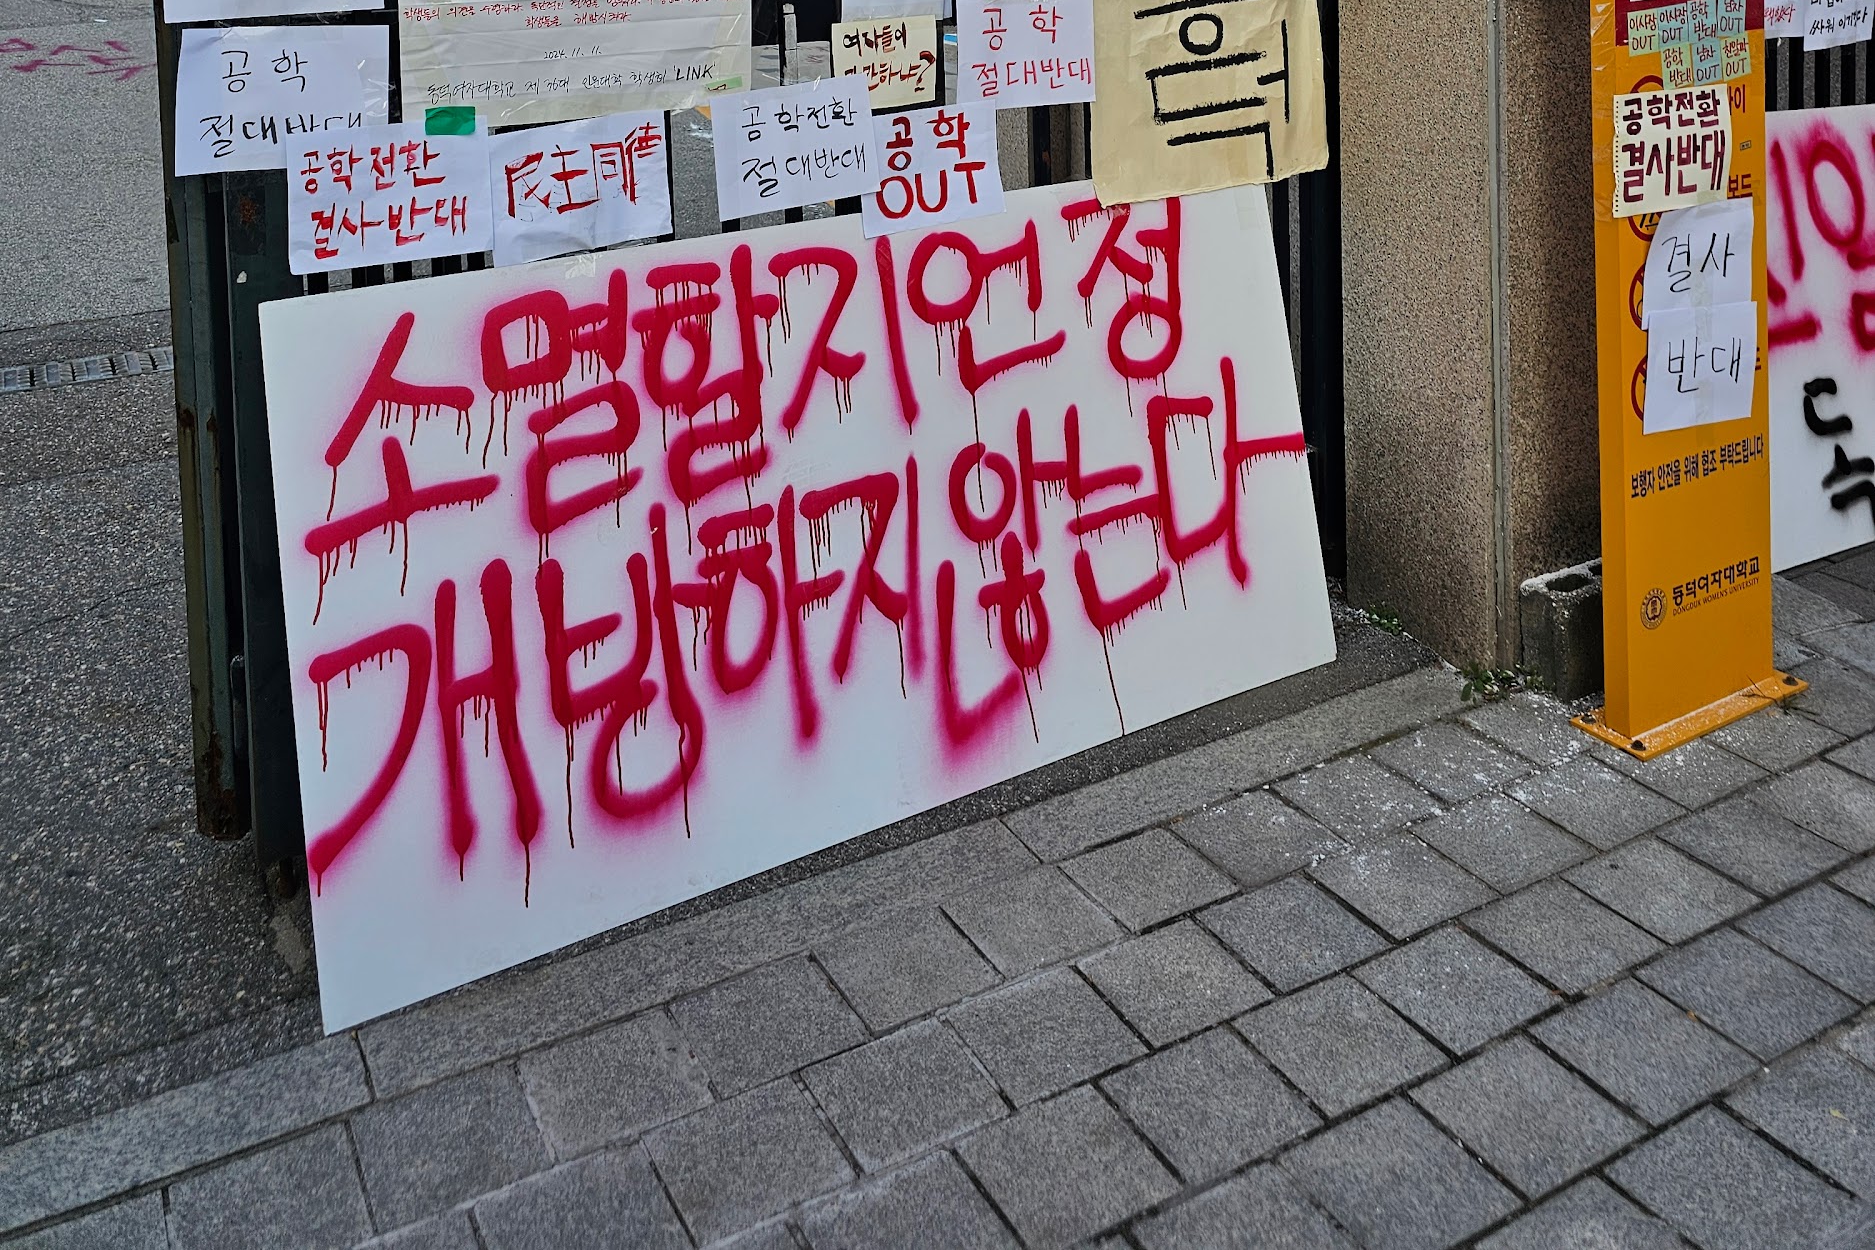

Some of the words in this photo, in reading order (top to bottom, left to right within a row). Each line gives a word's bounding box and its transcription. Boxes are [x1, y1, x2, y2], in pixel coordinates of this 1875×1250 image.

[981, 4, 1063, 51] 공학
[1630, 13, 1657, 31] 이사장
[1660, 6, 1687, 25] 이사장
[1690, 1, 1709, 20] 공학
[1694, 19, 1717, 41] 반대
[1720, 16, 1743, 33] OUT
[1809, 18, 1835, 35] 싸워
[843, 22, 906, 57] 여자들이
[1632, 35, 1655, 50] OUT
[1662, 27, 1683, 43] OUT
[1697, 44, 1716, 62] 남자
[221, 49, 308, 93] 공학
[971, 57, 1092, 97] 절대반대
[1663, 47, 1683, 68] 공학
[1697, 64, 1719, 81] OUT
[1726, 58, 1747, 77] OUT
[1670, 68, 1693, 87] 반대
[742, 96, 858, 142] 공학전환
[1623, 88, 1720, 136] 공학전환
[886, 109, 971, 171] 공학
[300, 139, 447, 194] 공학전환
[742, 142, 867, 198] 절대반대
[1622, 129, 1726, 203] 결사반대
[876, 161, 986, 219] OUT
[310, 195, 468, 260] 결사반대
[1662, 232, 1735, 292] 결사
[1668, 337, 1741, 394] 반대
[1631, 467, 1655, 498] 보행자
[1658, 459, 1681, 491] 안전을
[1684, 453, 1699, 482] 위해
[1702, 450, 1717, 477] 협조
[1720, 433, 1763, 470] 부탁드립니다
[1672, 556, 1760, 606] 동덕여자대학교
[1672, 600, 1701, 616] DONGDUK
[1703, 589, 1728, 604] WOMEN'S
[1729, 577, 1759, 595] UNIVERSITY
